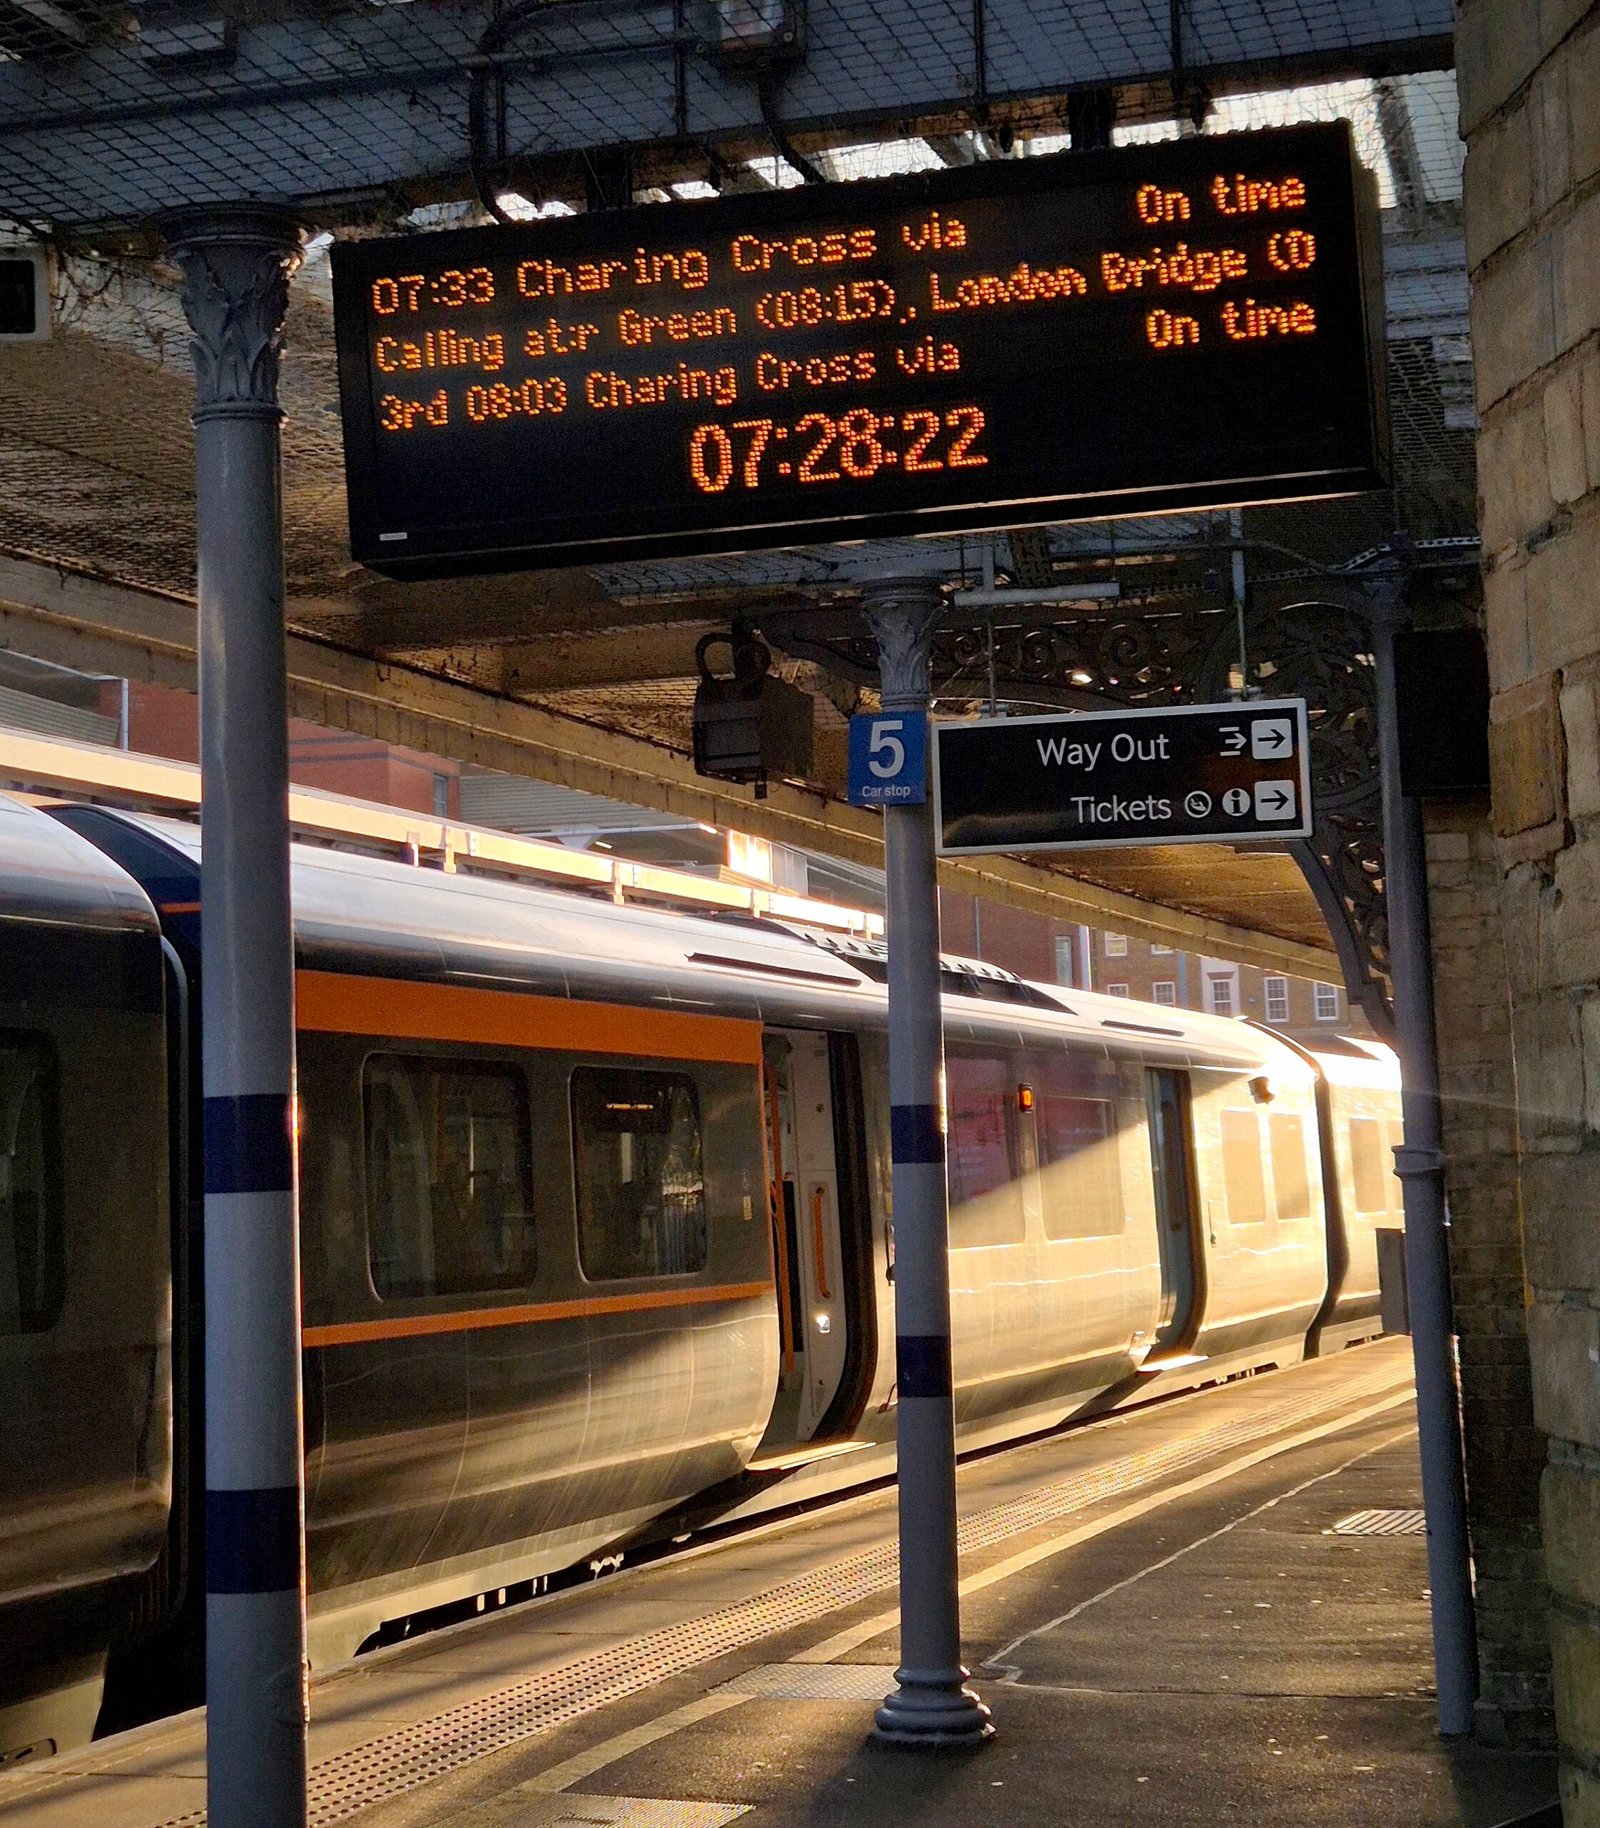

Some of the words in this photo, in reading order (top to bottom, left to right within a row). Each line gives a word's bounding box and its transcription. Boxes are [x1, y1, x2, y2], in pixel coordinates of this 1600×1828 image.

[372, 266, 495, 315] 07:33
[517, 246, 709, 297] Charing
[731, 232, 878, 272] Cross
[902, 211, 967, 251] via
[1136, 184, 1191, 224] On
[1211, 173, 1306, 215] time
[376, 327, 505, 372] Calling
[618, 307, 737, 347] Green
[930, 262, 1088, 311] London
[1101, 241, 1248, 292] Bridge
[381, 389, 449, 431] 3rd
[465, 376, 568, 422] 08:03
[585, 362, 737, 406] Charing
[755, 351, 877, 391] Cross
[896, 335, 961, 375] via
[1146, 308, 1200, 348] On
[1220, 298, 1317, 340] time
[689, 405, 989, 493] 07:28:22
[868, 719, 905, 779] 5
[1036, 736, 1102, 773] Way
[1111, 732, 1171, 763] Out
[861, 785, 882, 798] Car
[883, 783, 911, 800] stop
[1070, 793, 1173, 825] Tickets
